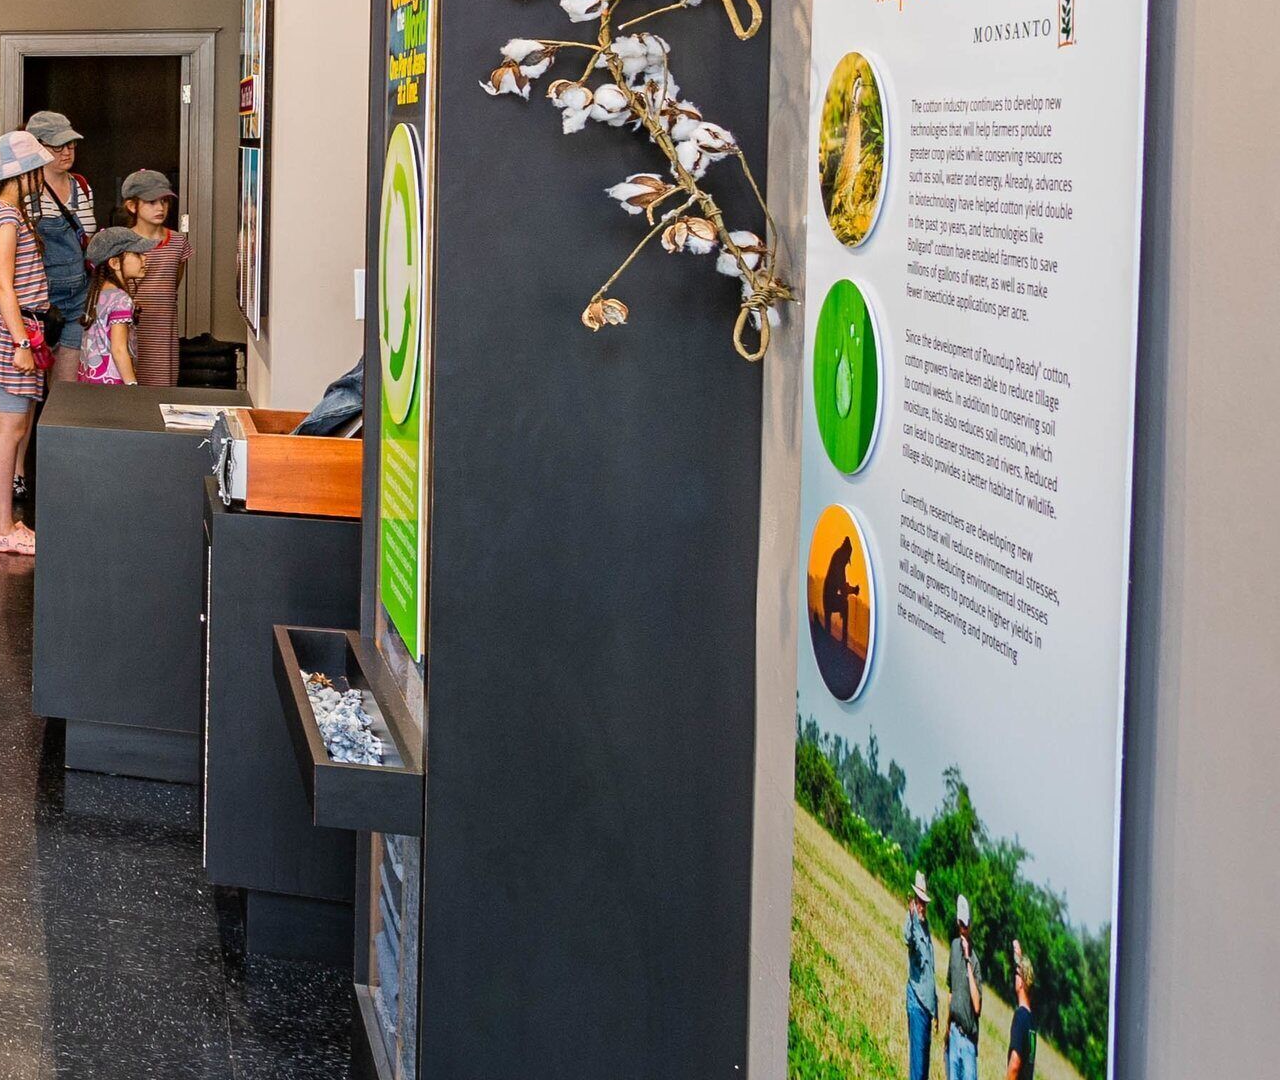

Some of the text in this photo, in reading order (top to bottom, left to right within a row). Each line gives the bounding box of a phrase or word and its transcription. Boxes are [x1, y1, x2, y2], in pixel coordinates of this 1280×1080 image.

[973, 18, 1051, 44] MONSANTO
[912, 95, 1062, 114] The cotton industry continues to develop new
